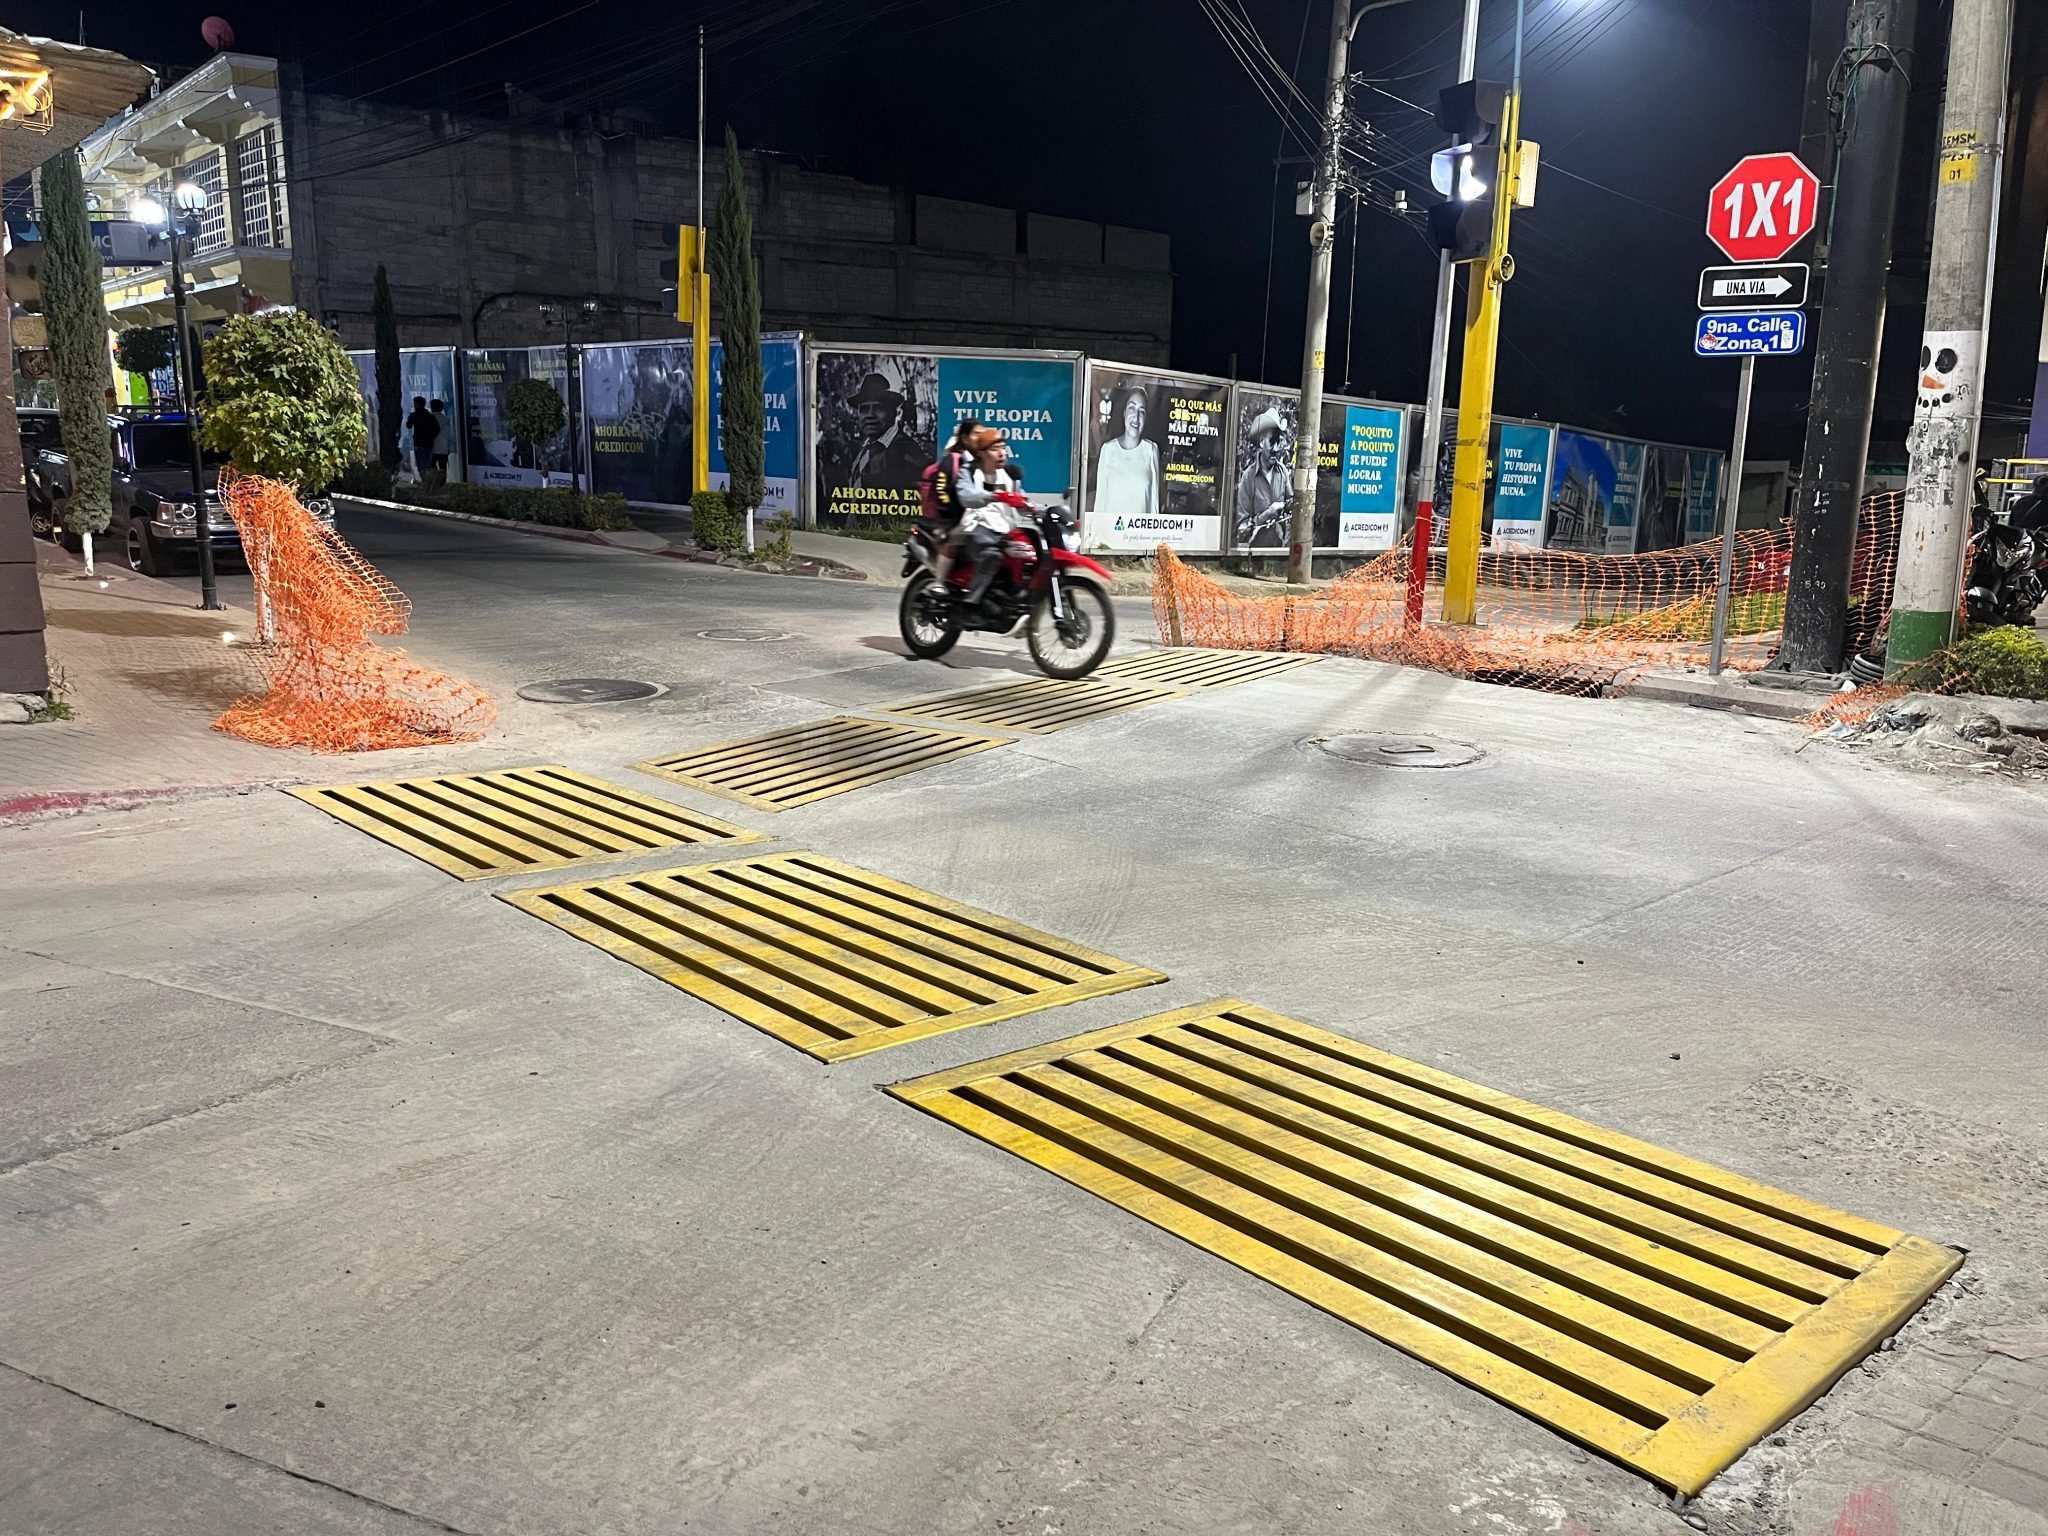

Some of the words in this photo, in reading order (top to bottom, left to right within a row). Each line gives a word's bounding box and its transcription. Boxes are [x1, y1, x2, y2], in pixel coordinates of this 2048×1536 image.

[1724, 178, 1803, 239] 1X1
[1726, 281, 1746, 294] UNA
[1749, 281, 1765, 293] VIA
[1707, 320, 1743, 333] 9na.
[1747, 318, 1791, 332] Calle
[408, 375, 427, 386] VIVE
[953, 390, 998, 404] VIVE
[1187, 400, 1204, 411] QUE
[1204, 400, 1222, 412] MÁS
[953, 408, 980, 421] TU
[984, 409, 1053, 423] PROPIA
[594, 441, 644, 453] ACREDICOM
[1328, 443, 1339, 453] EN
[1350, 441, 1357, 451] A
[1358, 441, 1395, 454] POQUITO
[1505, 448, 1523, 459] VIVE
[1350, 454, 1359, 465] SE
[1360, 455, 1388, 467] PUEDE
[1504, 460, 1515, 470] TU
[1515, 461, 1542, 472] PROPIA
[1348, 469, 1381, 481] LOGRAR
[1501, 473, 1537, 485] HISTORIA
[831, 486, 900, 501] AHORRA
[903, 489, 922, 501] EN
[1499, 486, 1526, 496] BUENA.
[828, 502, 924, 516] ACREDICOM
[1127, 518, 1183, 530] ACREDICOM
[1350, 523, 1382, 532] ACREDICOM
